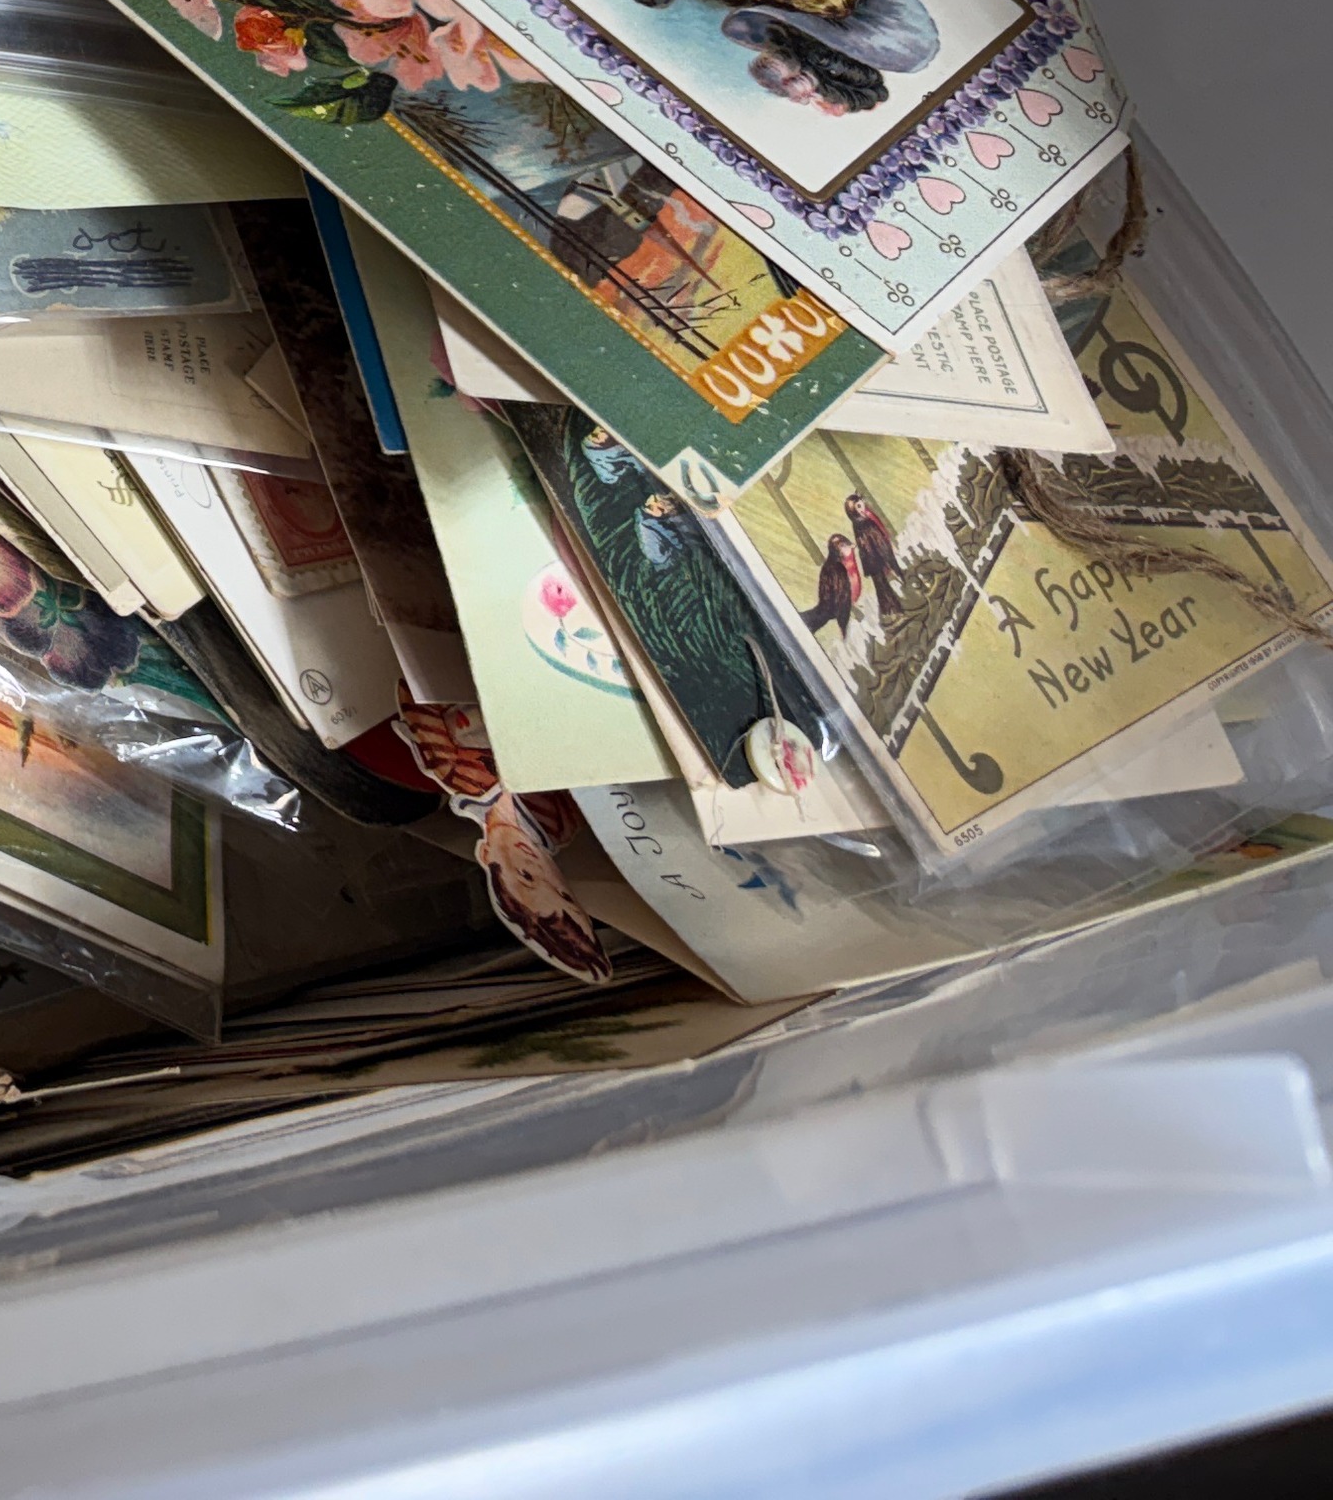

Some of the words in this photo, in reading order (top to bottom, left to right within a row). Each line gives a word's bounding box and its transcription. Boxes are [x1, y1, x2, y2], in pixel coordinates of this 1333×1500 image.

[175, 321, 195, 386] POSTAGE
[194, 334, 212, 375] PLACE
[950, 303, 974, 342] TAMP
[964, 345, 992, 384] HERE
[983, 335, 1019, 395] POSTAGE
[1027, 645, 1114, 710] New
[1109, 596, 1197, 664] Year
[953, 823, 984, 847] 6505
